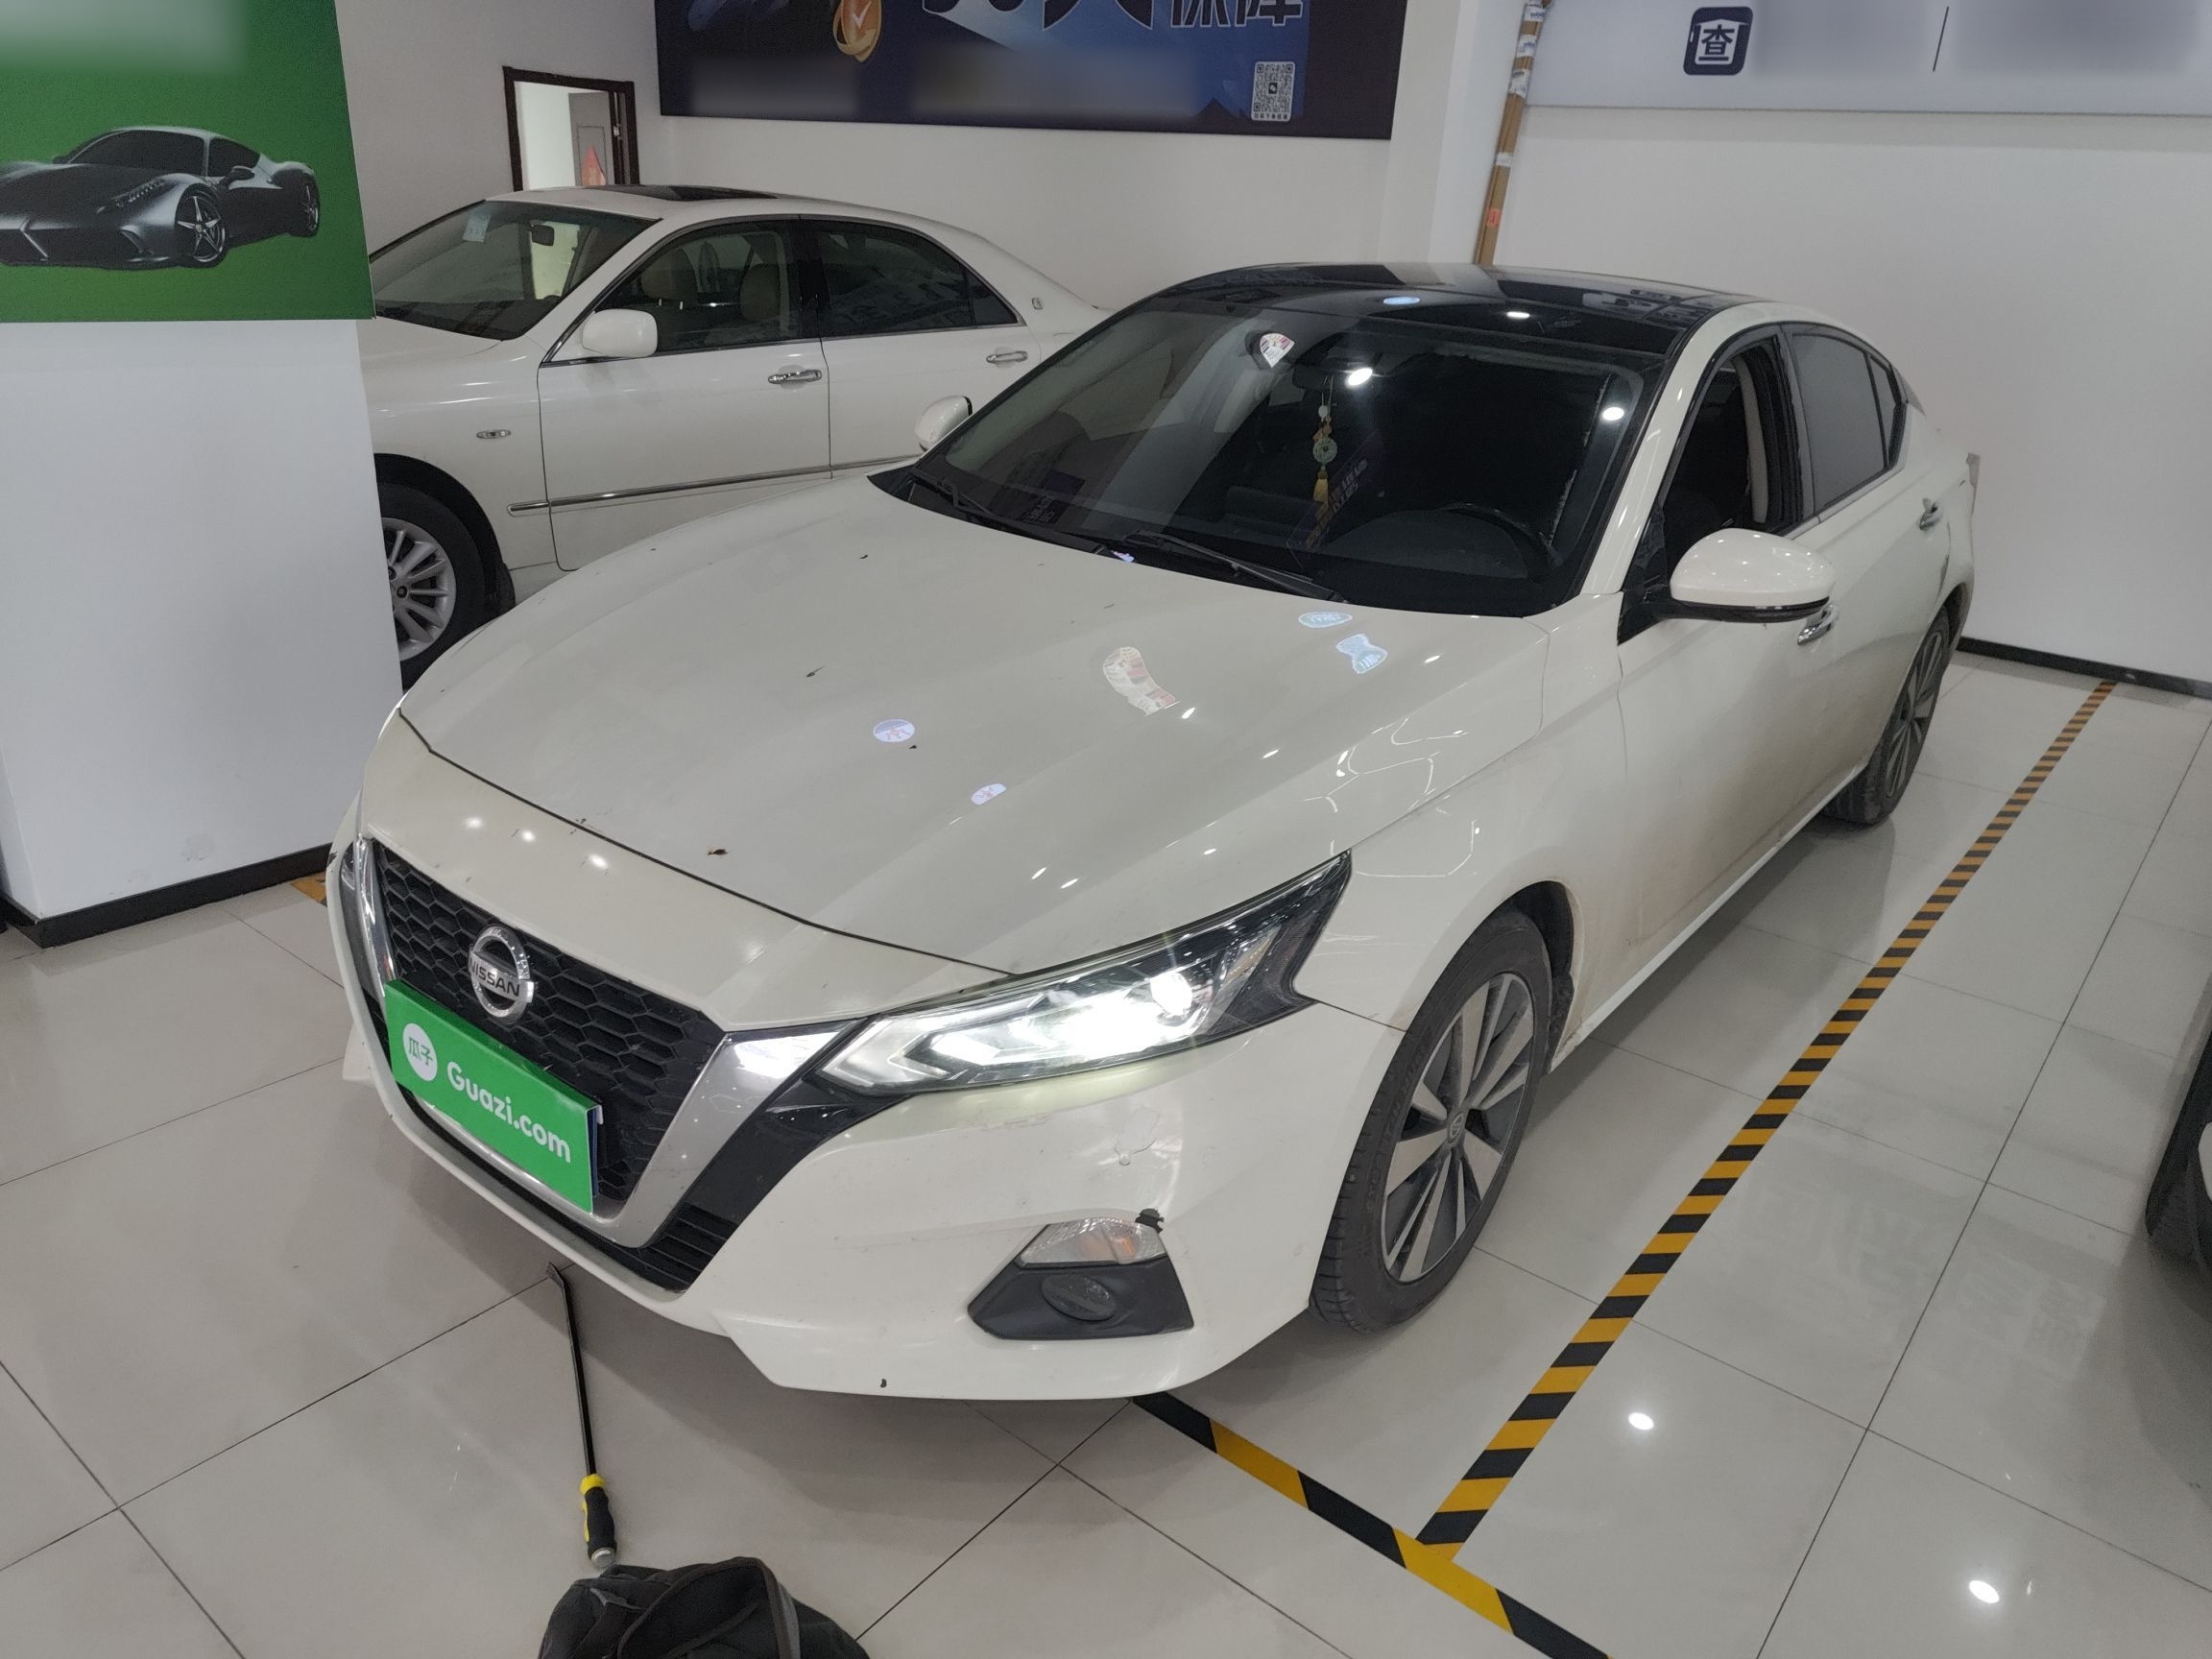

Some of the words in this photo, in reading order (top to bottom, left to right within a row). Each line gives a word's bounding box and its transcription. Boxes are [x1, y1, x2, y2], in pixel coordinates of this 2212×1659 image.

[1698, 24, 1735, 61] 查
[469, 957, 520, 997] NISSAN
[409, 1037, 434, 1067] 瓜子
[446, 1061, 571, 1164] Guazi.com
